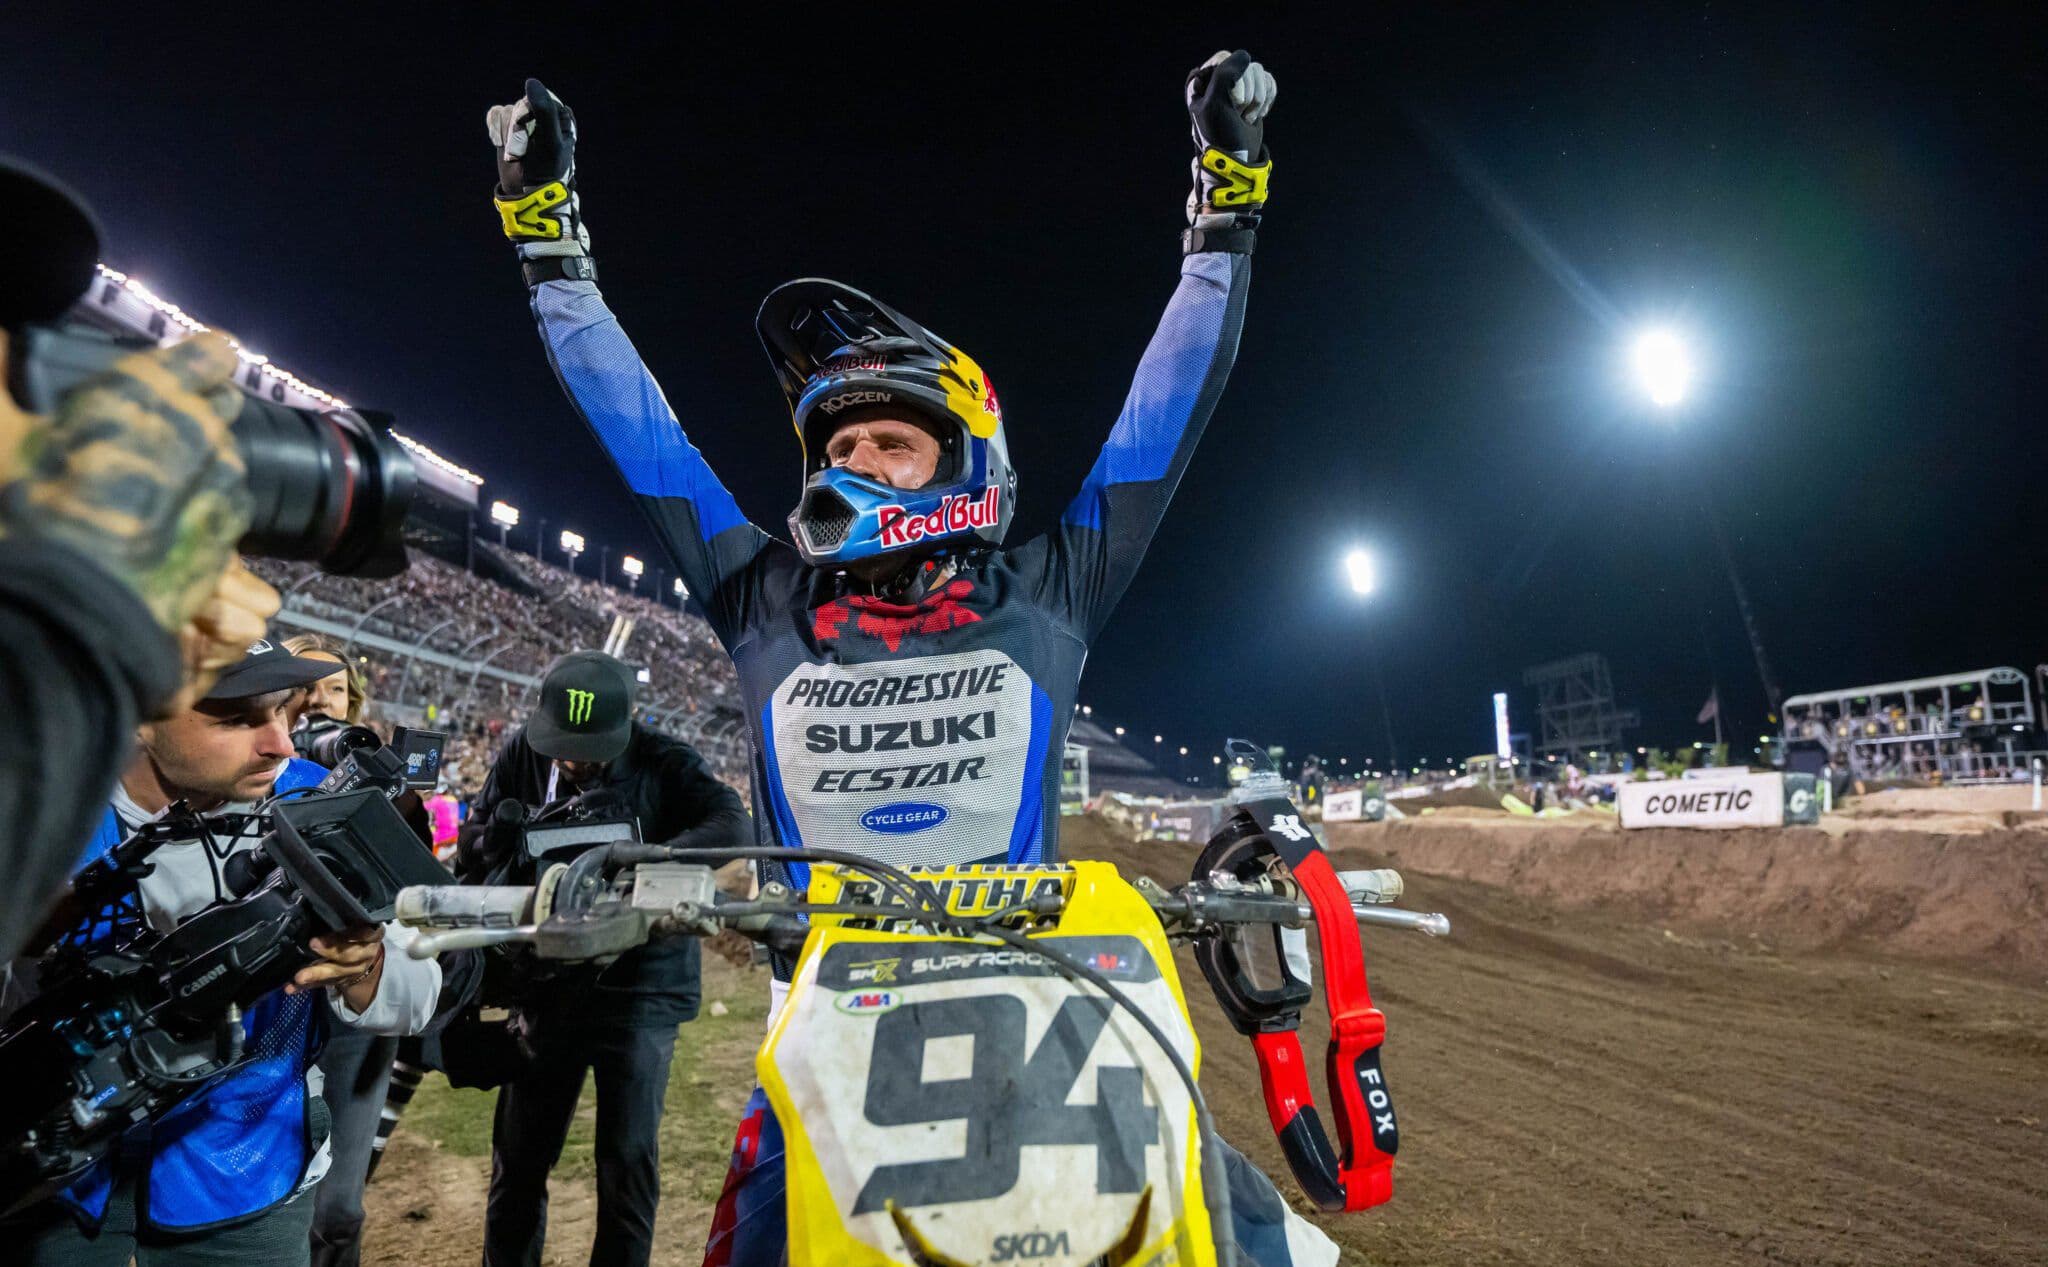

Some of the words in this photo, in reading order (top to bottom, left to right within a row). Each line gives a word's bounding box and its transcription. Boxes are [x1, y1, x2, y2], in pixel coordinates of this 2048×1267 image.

[845, 353, 887, 371] Bull
[819, 391, 892, 415] ROCZEN
[878, 497, 950, 549] Red
[948, 485, 999, 531] Bull
[786, 663, 1009, 708] PROGRESSIVE
[805, 710, 996, 754] SUZUKI
[811, 756, 991, 793] ECSTAR
[866, 814, 903, 826] CYCLE
[905, 810, 939, 823] GEAR
[1646, 790, 1753, 815] COMETIC
[837, 878, 1065, 911] RENTHA
[181, 963, 228, 997] Canon
[847, 993, 890, 1008] AMA
[851, 993, 1159, 1217] 94
[1360, 1068, 1395, 1135] FOX
[989, 1230, 1071, 1263] SKDA
